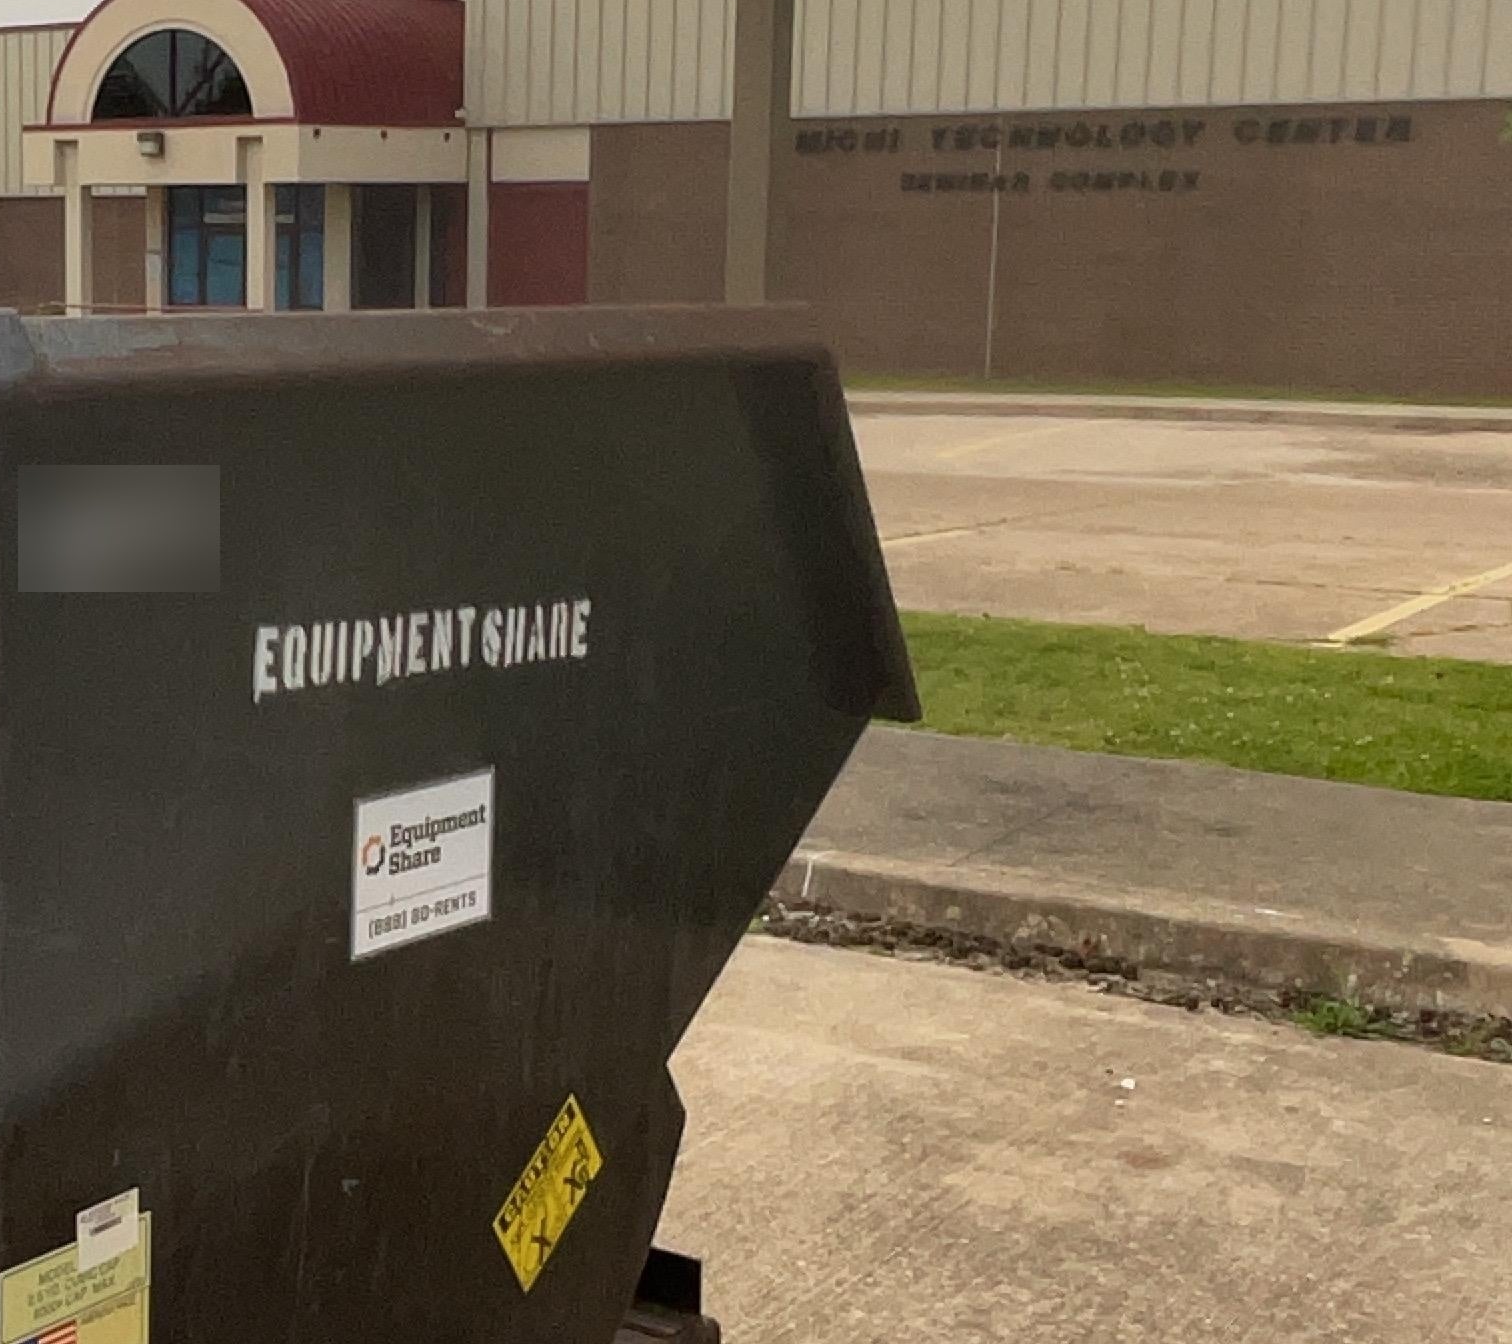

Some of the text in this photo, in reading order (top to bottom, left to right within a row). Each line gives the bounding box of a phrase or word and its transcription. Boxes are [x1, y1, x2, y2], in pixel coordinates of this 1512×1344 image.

[931, 120, 1205, 152] TECHNOLOGY
[1233, 116, 1413, 145] CENTER
[390, 803, 486, 848] Equipment
[389, 846, 442, 876] Share
